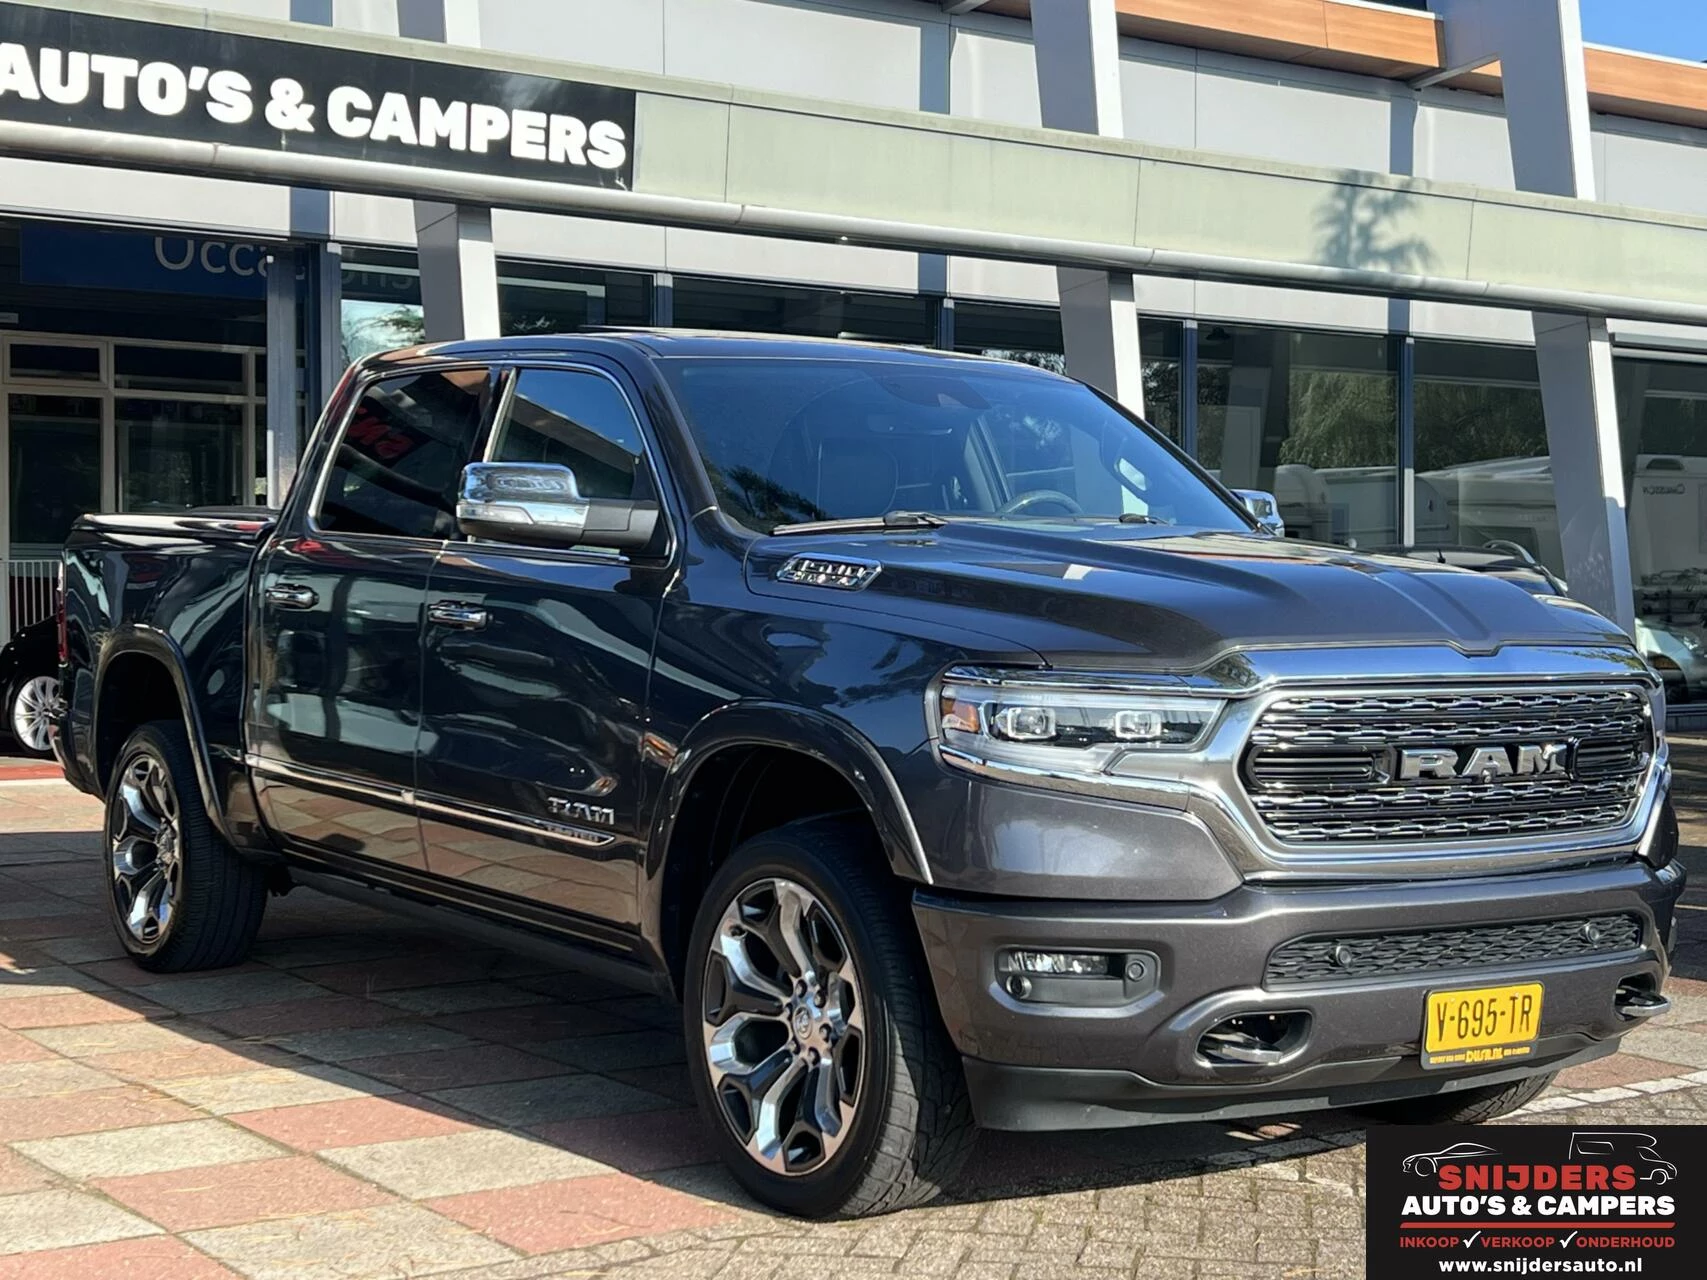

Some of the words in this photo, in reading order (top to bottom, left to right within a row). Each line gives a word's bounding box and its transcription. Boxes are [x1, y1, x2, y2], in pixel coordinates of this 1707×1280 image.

[264, 77, 315, 133] &
[327, 86, 627, 169] CAMPERS
[1402, 744, 1567, 779] RAM
[1437, 995, 1532, 1042] V-695-TR
